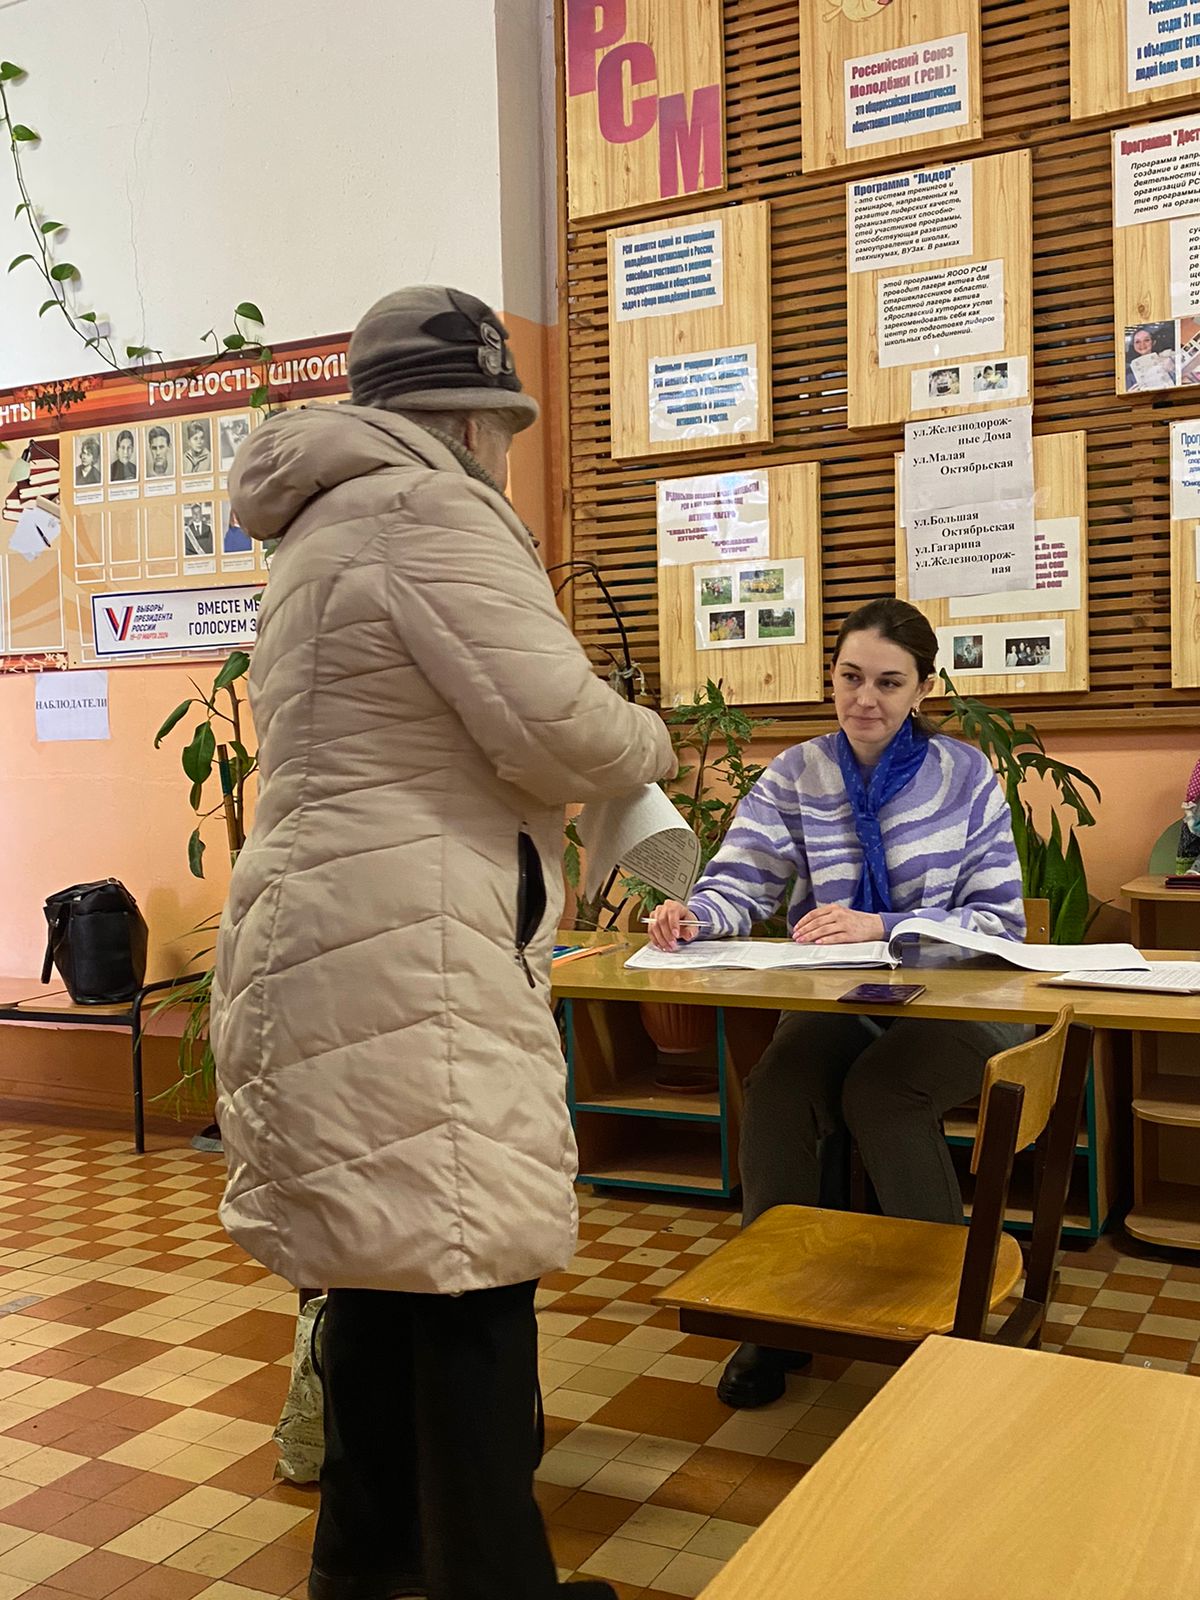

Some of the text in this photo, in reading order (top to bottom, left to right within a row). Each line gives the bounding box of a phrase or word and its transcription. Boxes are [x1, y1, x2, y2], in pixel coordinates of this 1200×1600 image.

[1184, 13, 1191, 27] 31
[852, 47, 954, 79] Российский Союз
[1136, 61, 1158, 80] людей
[1159, 60, 1178, 75] более
[850, 76, 910, 99] Молодёжи
[1121, 134, 1171, 155] Программа
[1131, 152, 1200, 170] Программа напр
[854, 167, 956, 196] Программа "Лидер"
[1134, 167, 1171, 178] создание
[1134, 171, 1196, 187] деятельности
[875, 190, 905, 201] система
[907, 184, 947, 196] тренингов
[1134, 181, 1186, 196] организаций
[855, 202, 894, 212] семинаров,
[896, 192, 947, 205] направленных
[1134, 197, 1150, 205] тие
[1134, 205, 1158, 214] ленно
[854, 211, 889, 222] развитие
[890, 204, 927, 215] лидерских
[855, 207, 955, 229] организаторских способно-
[855, 214, 962, 237] стей участников программы,
[855, 223, 957, 246] способствующая развитию
[623, 244, 632, 255] РСМ
[855, 239, 913, 254] самоуправления
[921, 233, 950, 243] школах,
[856, 251, 899, 262] техникумах,
[902, 246, 925, 254] ВУЗах.
[934, 240, 959, 249] рамках
[883, 280, 901, 288] этой
[903, 274, 945, 285] программы
[971, 265, 987, 274] РСМ
[883, 286, 919, 297] проводит
[921, 282, 946, 290] лагеря
[948, 277, 974, 286] актива
[883, 284, 988, 305] старшеклассников области.
[884, 293, 980, 313] Областной лагерь актива
[884, 315, 948, 330] зарекомендовать
[950, 311, 966, 319] себя
[884, 329, 907, 338] центр
[920, 321, 963, 332] подготовке
[964, 315, 995, 325] лидеров
[885, 328, 972, 346] школьных объединений.
[148, 352, 348, 406] ГОРДОСТЬ ШКОЛ
[913, 417, 1012, 440] ул.Железнодорож-
[958, 430, 1012, 445] ные Дома
[913, 452, 965, 467] ул.Малая
[940, 459, 1013, 476] Октябрьская
[914, 511, 979, 529] ул.Большая
[941, 521, 1015, 538] Октябрьская
[915, 540, 981, 556] ул.Гагарина
[915, 551, 1015, 570] ул.Железнодорож-
[991, 566, 1011, 574] ная
[136, 603, 164, 612] ВЫБОРЫ
[198, 600, 240, 615] ВМЕСТЕ
[134, 612, 173, 622] ПРЕЗИДЕНТА
[132, 624, 157, 632] РОССИИ
[189, 619, 246, 636] ГОЛОСУЕМ
[35, 697, 108, 711] НАБЛЮДАТЕЛИ
